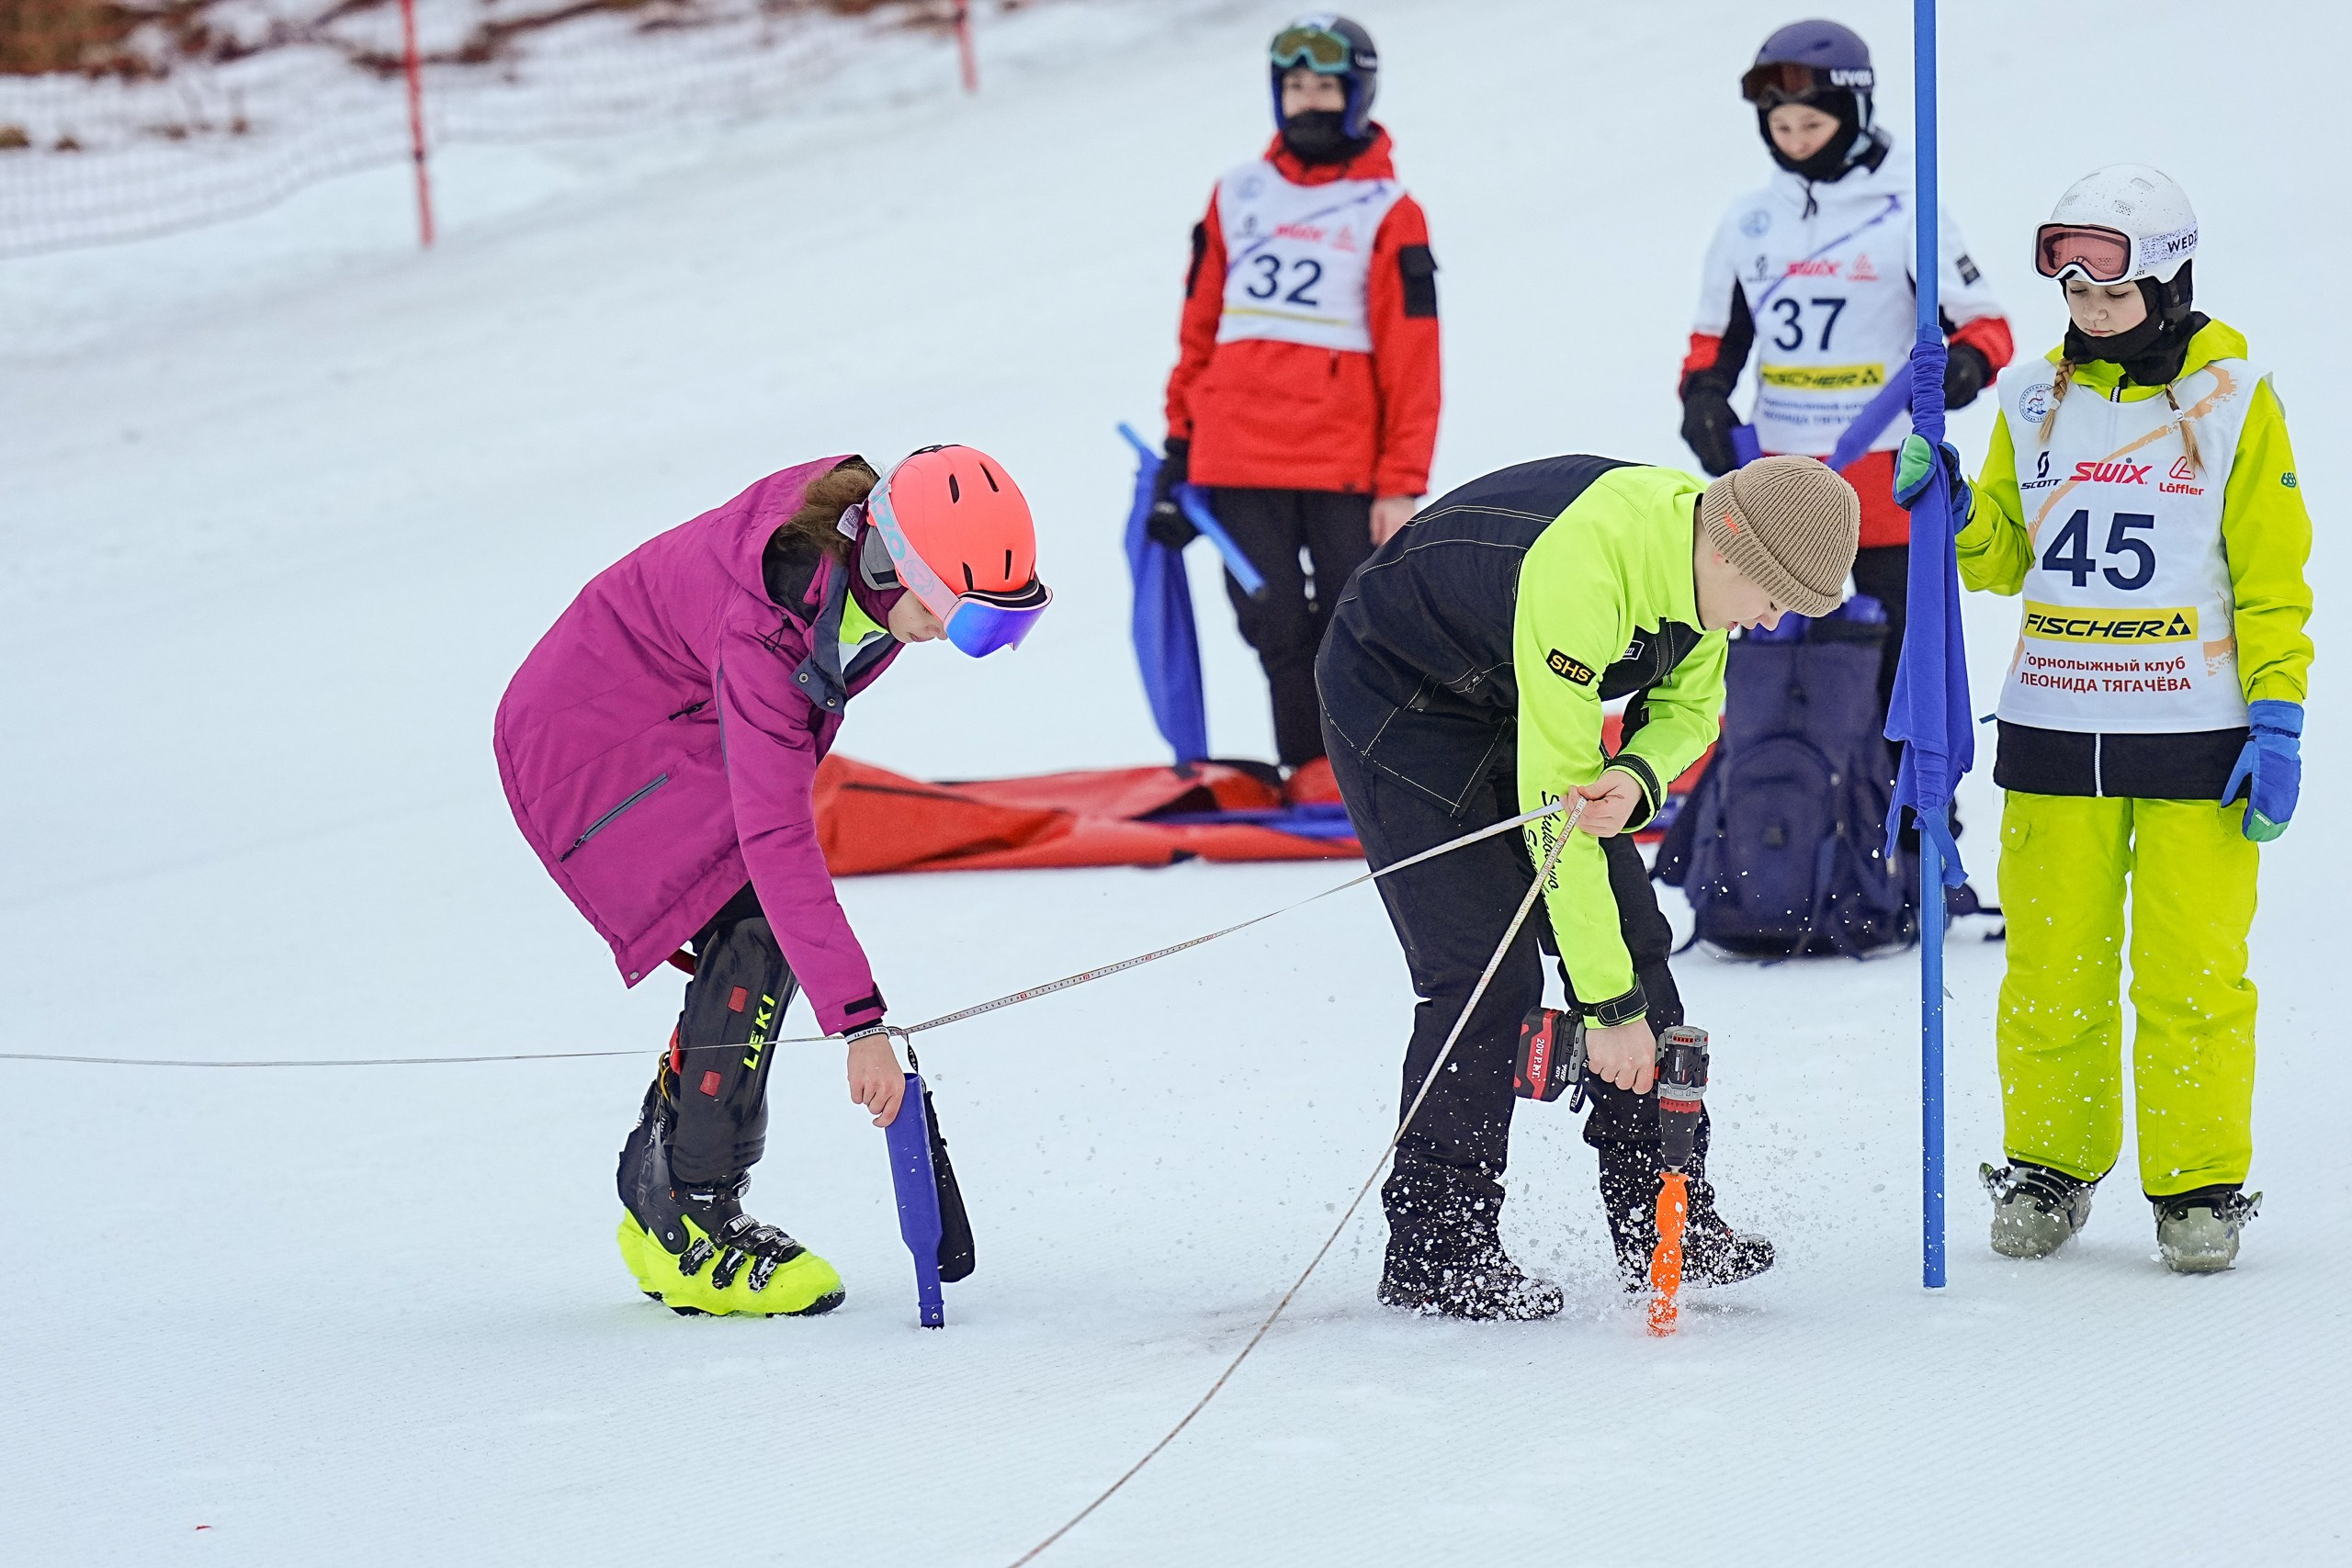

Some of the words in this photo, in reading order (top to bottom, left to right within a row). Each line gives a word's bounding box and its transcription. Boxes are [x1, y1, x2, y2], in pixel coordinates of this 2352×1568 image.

[1247, 254, 1321, 306] 32
[1772, 298, 1847, 352] 37
[2020, 479, 2062, 490] SCOTT
[2042, 509, 2155, 591] 45
[2025, 613, 2165, 638] FISCHER
[1550, 654, 1591, 682] SHS
[2144, 656, 2186, 675] клуб
[2020, 672, 2098, 694] ЛЕОНИДА
[2102, 676, 2191, 692] ТЯГАЧЁВА
[743, 994, 775, 1070] LEKI
[1535, 1038, 1545, 1055] 20V
